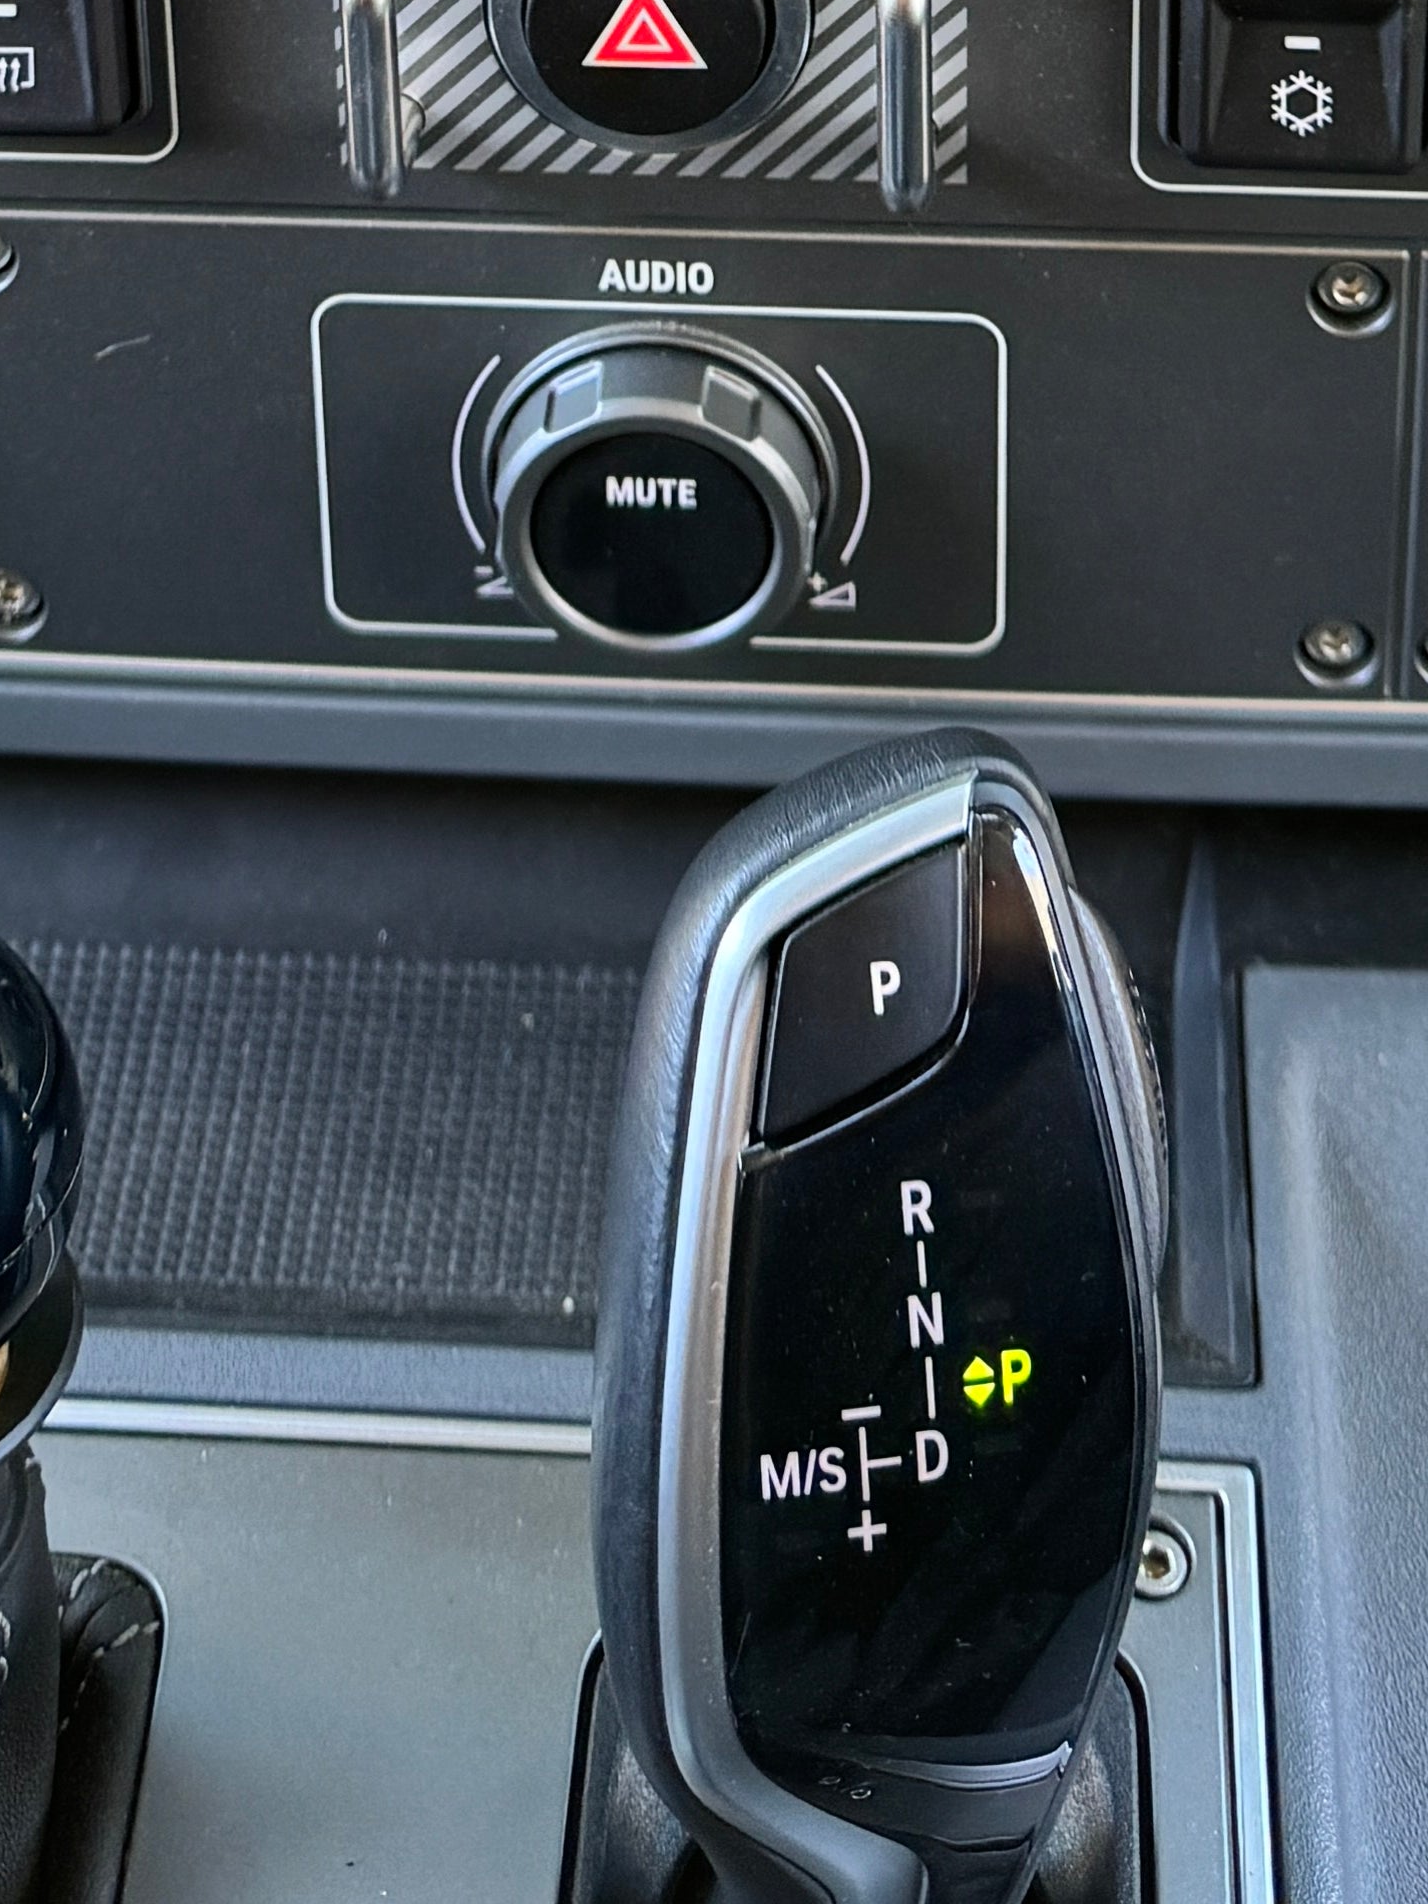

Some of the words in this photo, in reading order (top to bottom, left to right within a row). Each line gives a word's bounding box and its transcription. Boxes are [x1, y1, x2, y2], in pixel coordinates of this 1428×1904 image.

[599, 259, 714, 294] AUDIO
[606, 476, 696, 508] MUTE
[870, 961, 900, 1015] P
[901, 1180, 934, 1235] R
[908, 1292, 944, 1348] N
[1001, 1349, 1031, 1404] P
[761, 1447, 846, 1500] M/S
[916, 1430, 948, 1482] D
